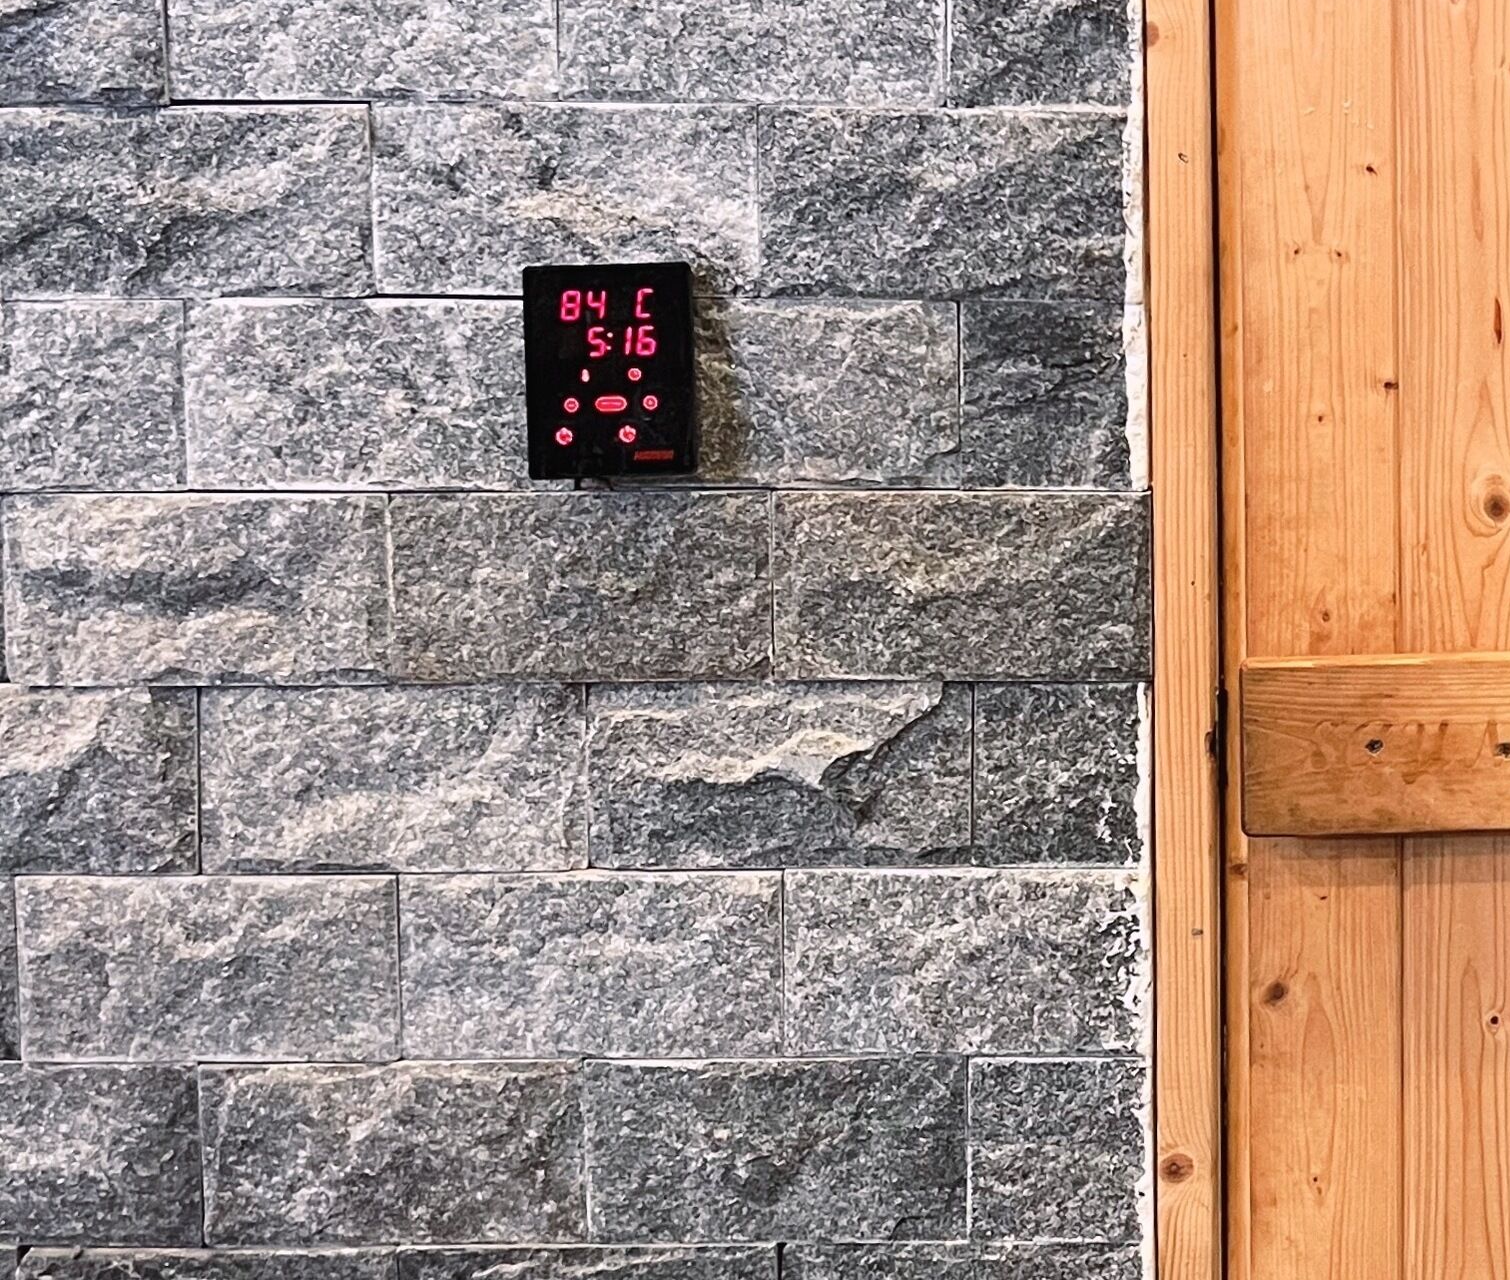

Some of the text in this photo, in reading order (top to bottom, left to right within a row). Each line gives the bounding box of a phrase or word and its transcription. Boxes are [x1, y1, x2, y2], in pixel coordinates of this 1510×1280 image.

[559, 287, 655, 321] 84 C
[587, 324, 658, 358] 5:16
